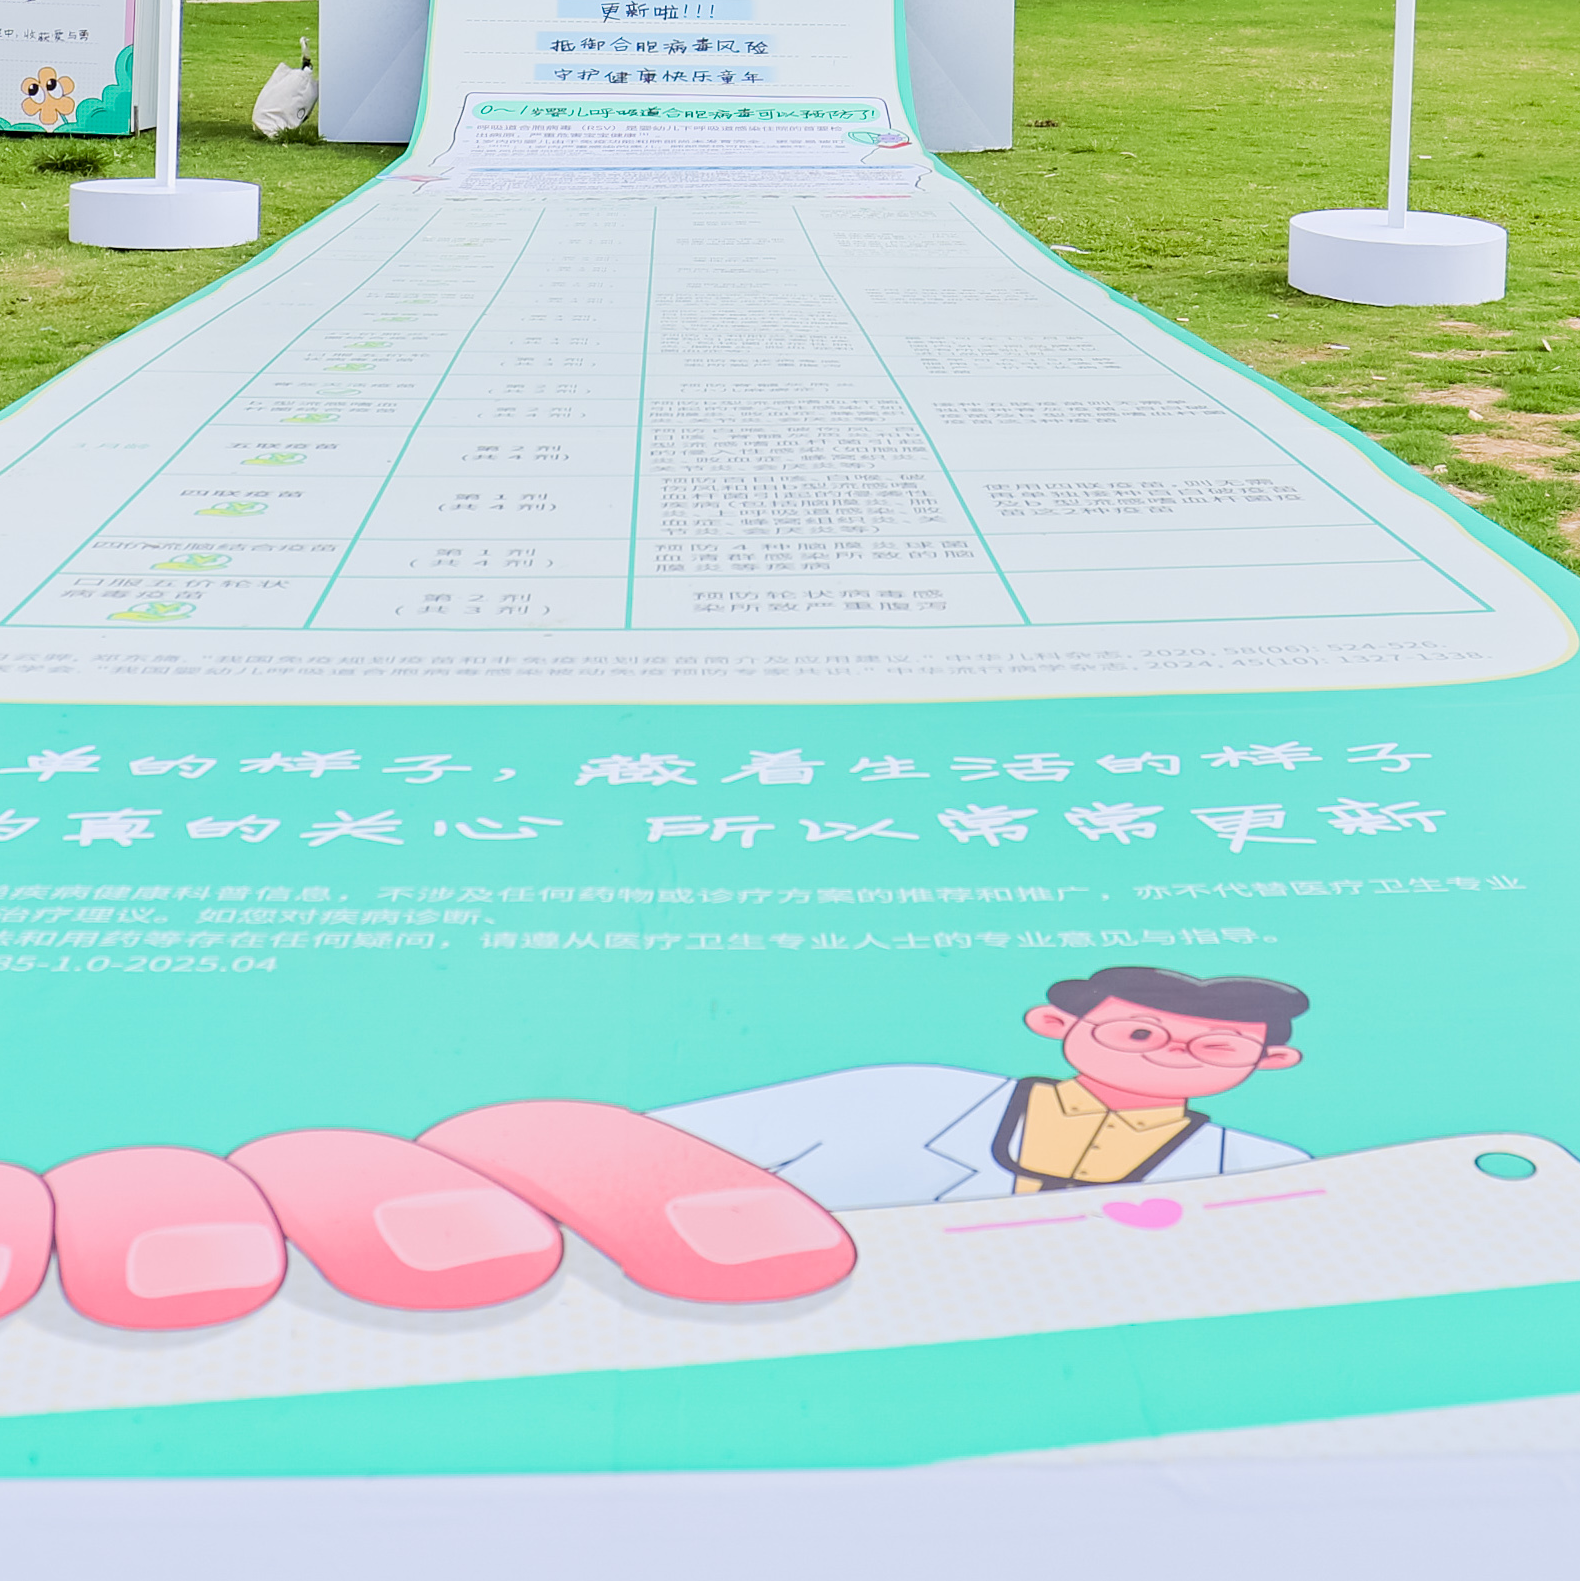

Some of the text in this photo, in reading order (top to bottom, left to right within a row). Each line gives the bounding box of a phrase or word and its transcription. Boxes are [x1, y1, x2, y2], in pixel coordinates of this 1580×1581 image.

[550, 37, 768, 56] 抵御合胞病毒风险
[554, 68, 764, 85] 守护健康快乐童年
